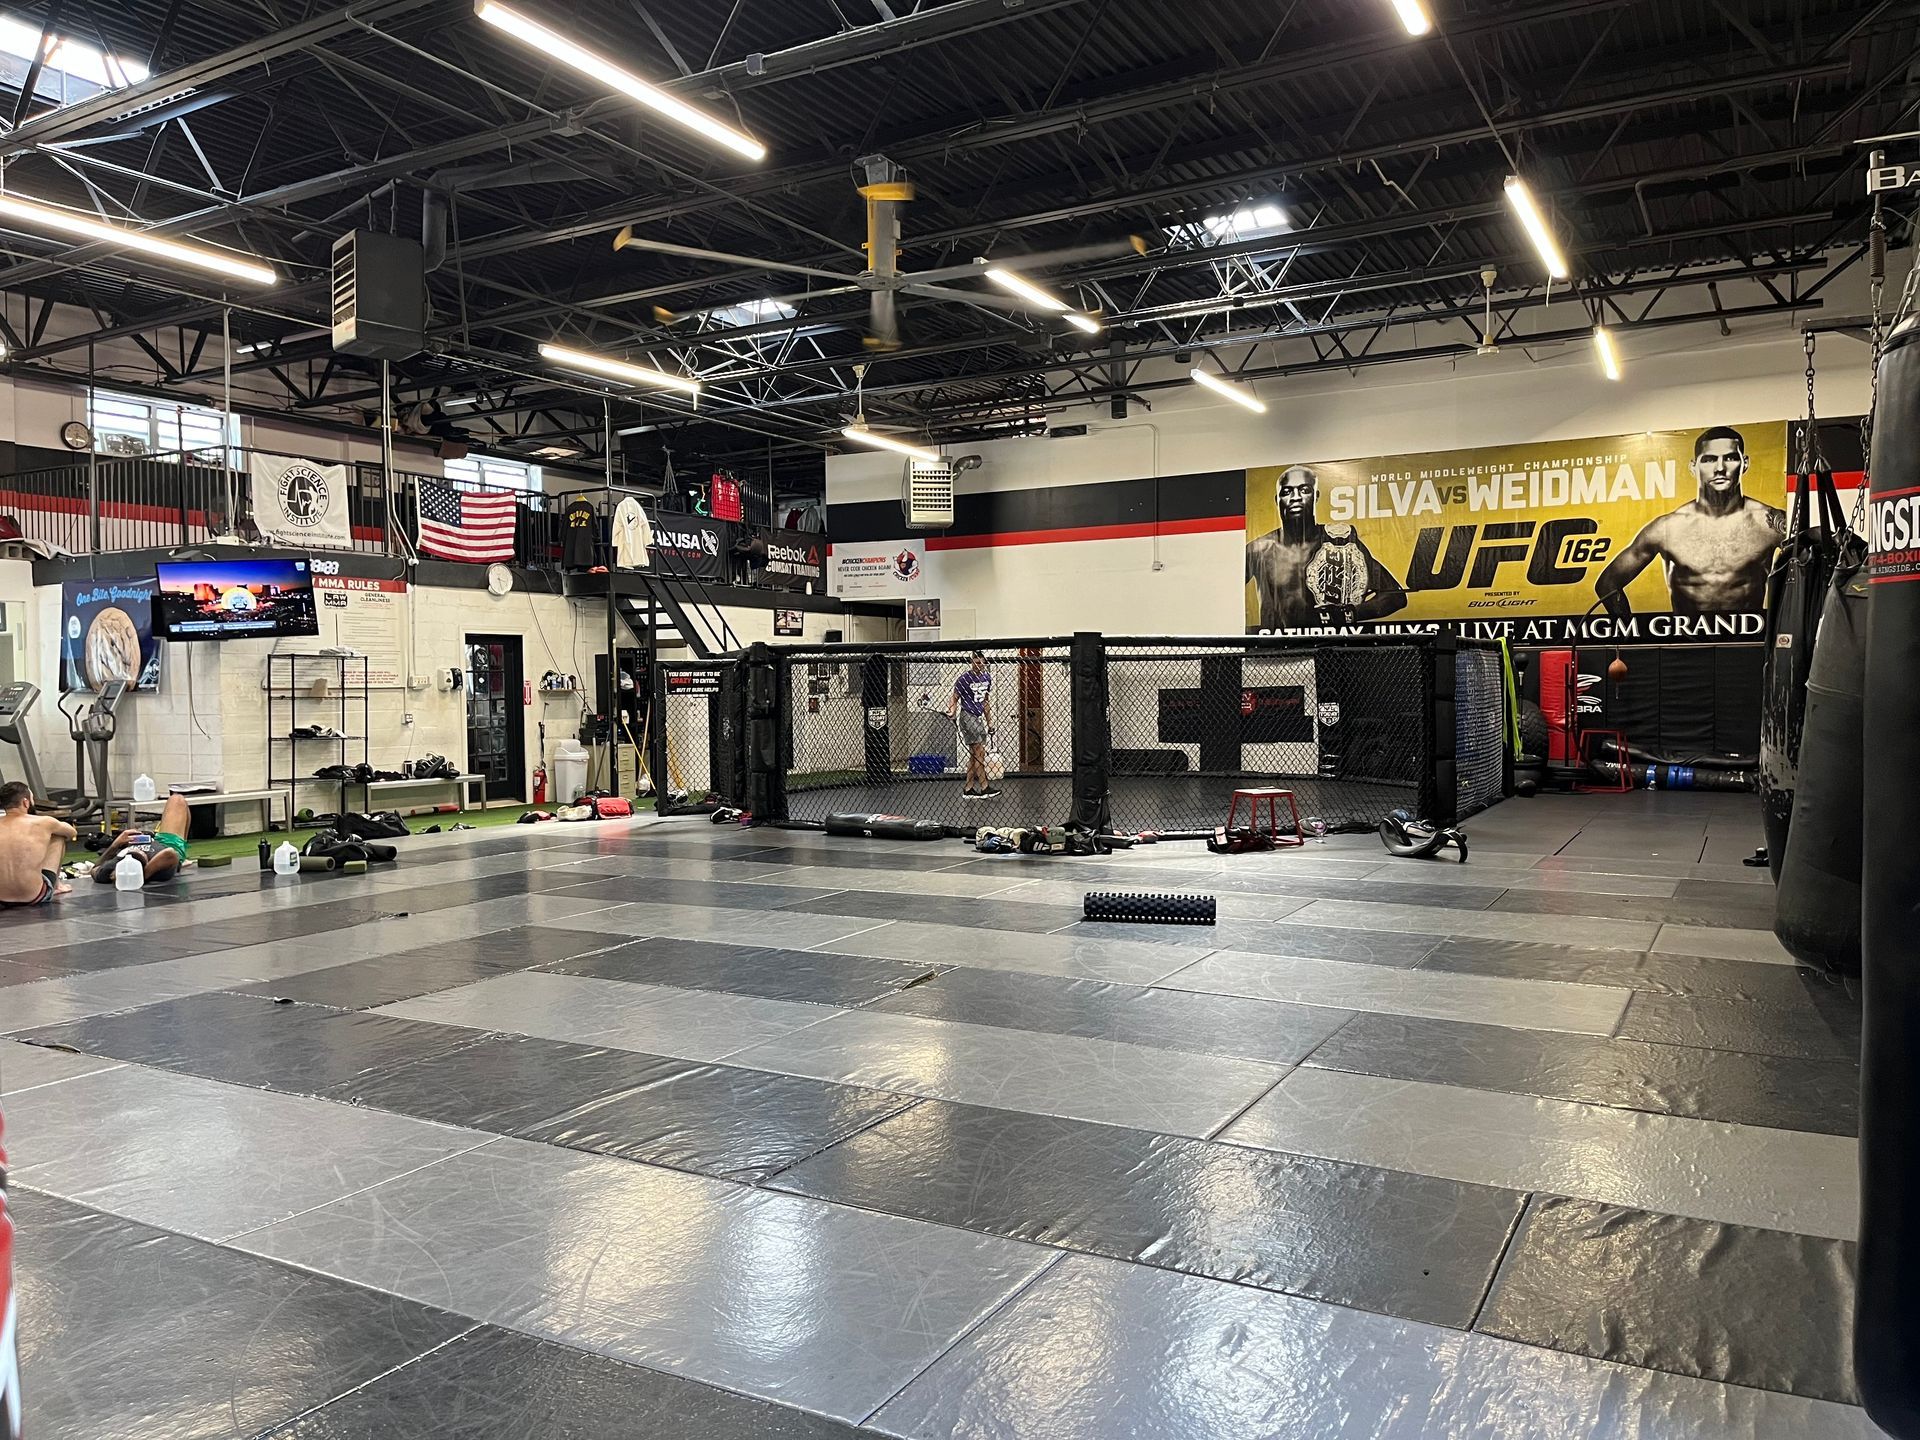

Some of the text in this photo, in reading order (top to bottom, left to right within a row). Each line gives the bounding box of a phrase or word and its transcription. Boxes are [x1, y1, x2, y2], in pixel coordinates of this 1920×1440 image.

[1371, 454, 1627, 483] WORLD MIDDLEWEIGHT CHAMPIONSHIP
[280, 468, 327, 501] FIGHT SCIENCE
[1330, 479, 1442, 521] SILVA
[1468, 460, 1676, 512] WEIDMAN
[284, 506, 323, 526] INSTITUTE
[652, 530, 701, 550] ABUSA
[768, 544, 806, 564] Reebok
[1406, 518, 1612, 590] UFC 162
[766, 561, 820, 578] COMBAT TRAINING
[318, 577, 345, 589] MMA
[348, 579, 380, 591] RULES
[76, 592, 91, 607] One
[110, 586, 152, 603] Goodnight
[1468, 599, 1538, 608] BUD LIGHT
[1457, 620, 1515, 640] LIVE
[1522, 619, 1557, 640] AT
[1563, 617, 1640, 640] MGM
[1649, 613, 1765, 636] GRAND
[1577, 705, 1602, 713] BRA
